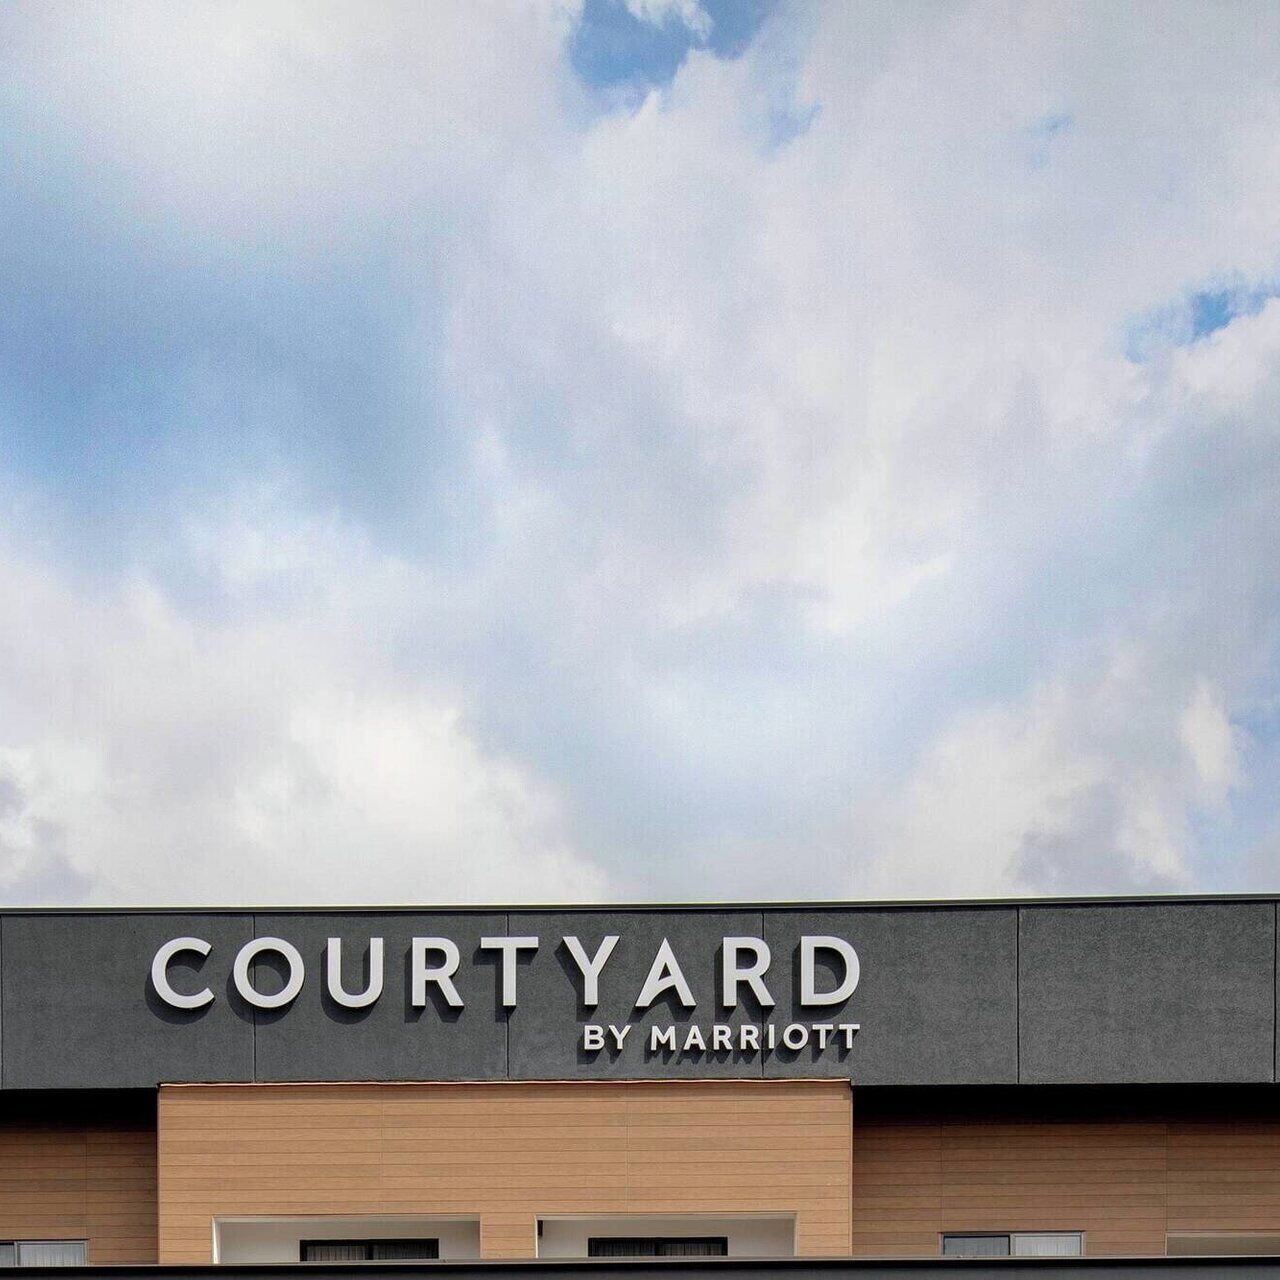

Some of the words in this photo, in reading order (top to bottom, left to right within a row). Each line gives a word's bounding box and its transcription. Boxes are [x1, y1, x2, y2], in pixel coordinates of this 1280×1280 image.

[151, 935, 861, 1009] COURTYARD
[584, 1024, 632, 1050] BY
[650, 1023, 861, 1051] MARRIOTT
